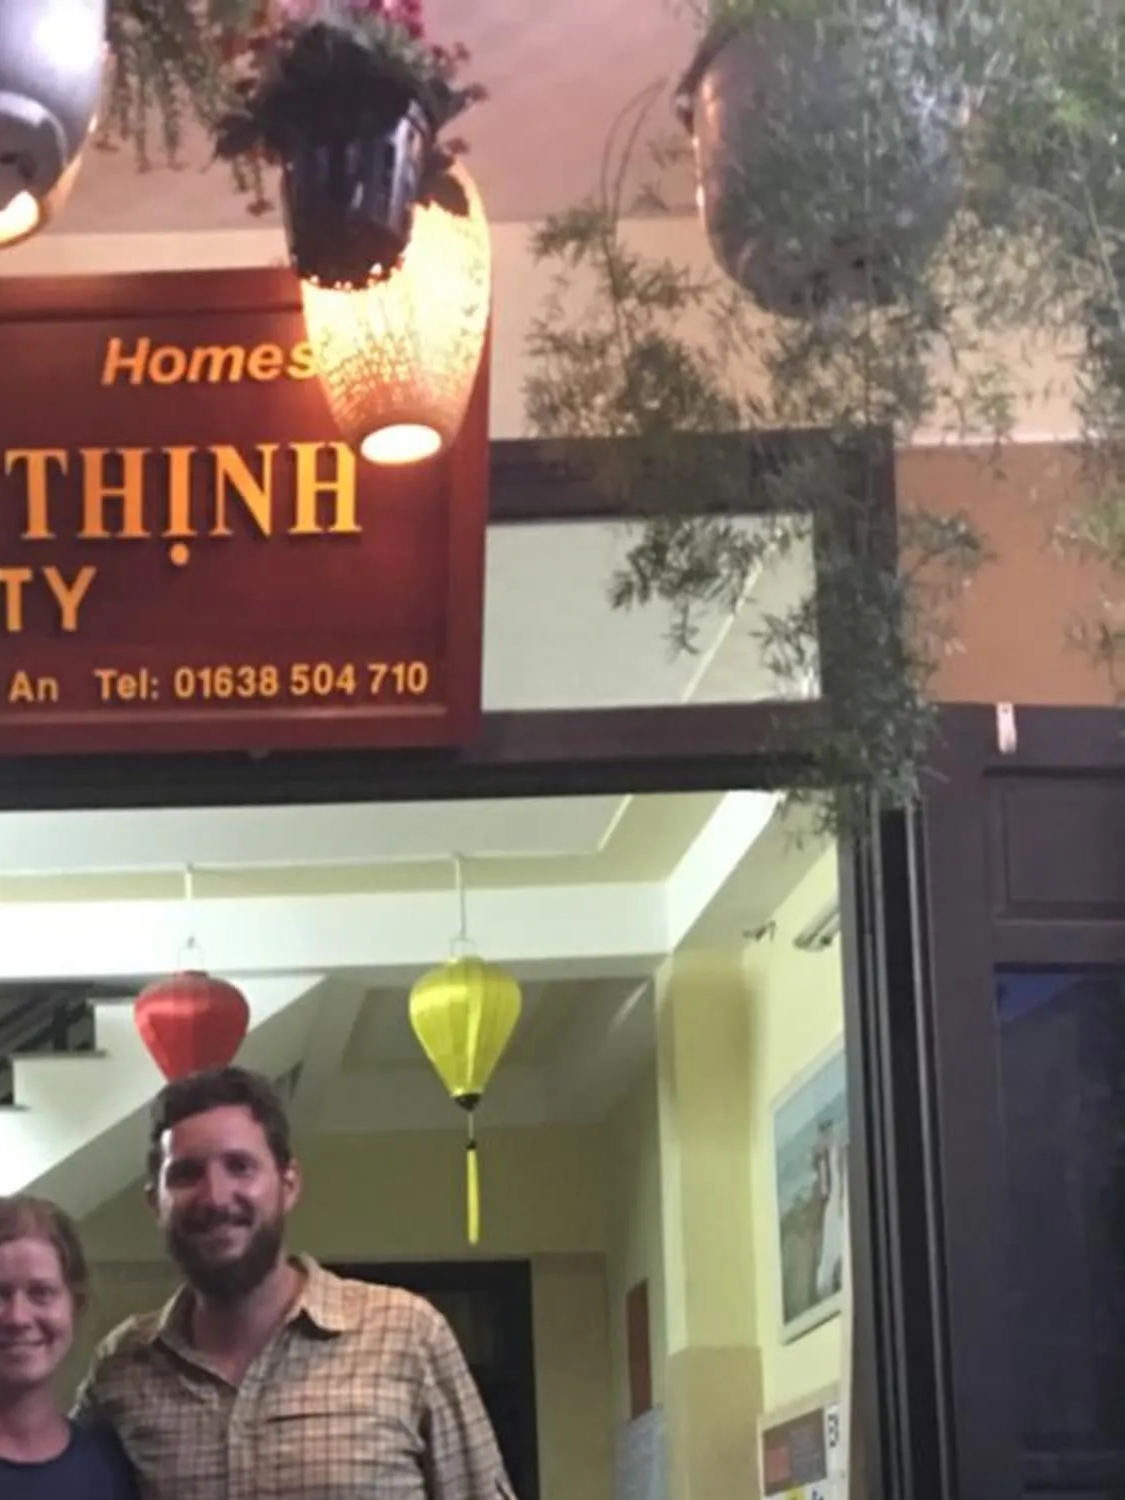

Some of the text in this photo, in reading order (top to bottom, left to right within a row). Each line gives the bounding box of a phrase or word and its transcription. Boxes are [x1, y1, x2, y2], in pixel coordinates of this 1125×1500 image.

[4, 441, 362, 566] THỊNH
[9, 670, 59, 703] An
[94, 668, 159, 700] Tel:
[175, 665, 279, 697] 01638
[290, 662, 356, 695] 504
[368, 661, 429, 694] 710
